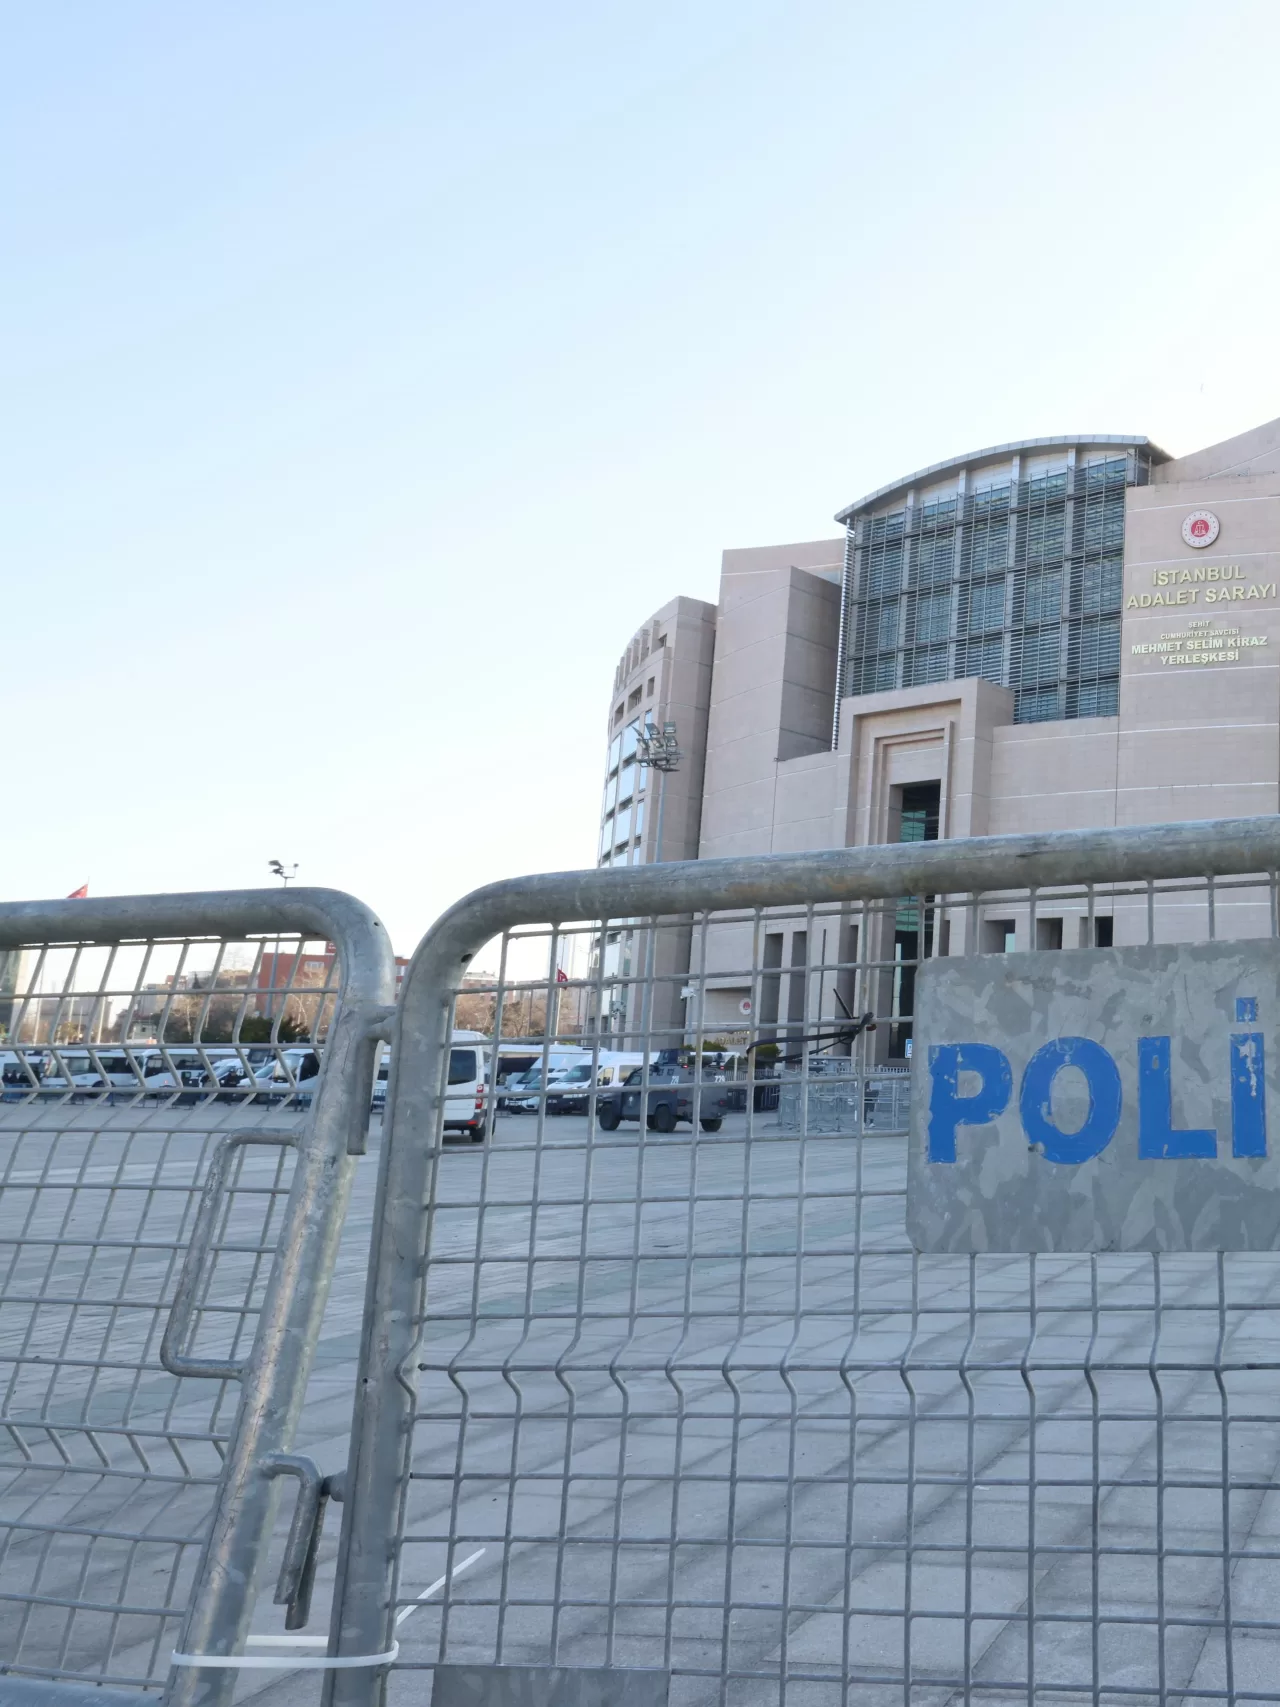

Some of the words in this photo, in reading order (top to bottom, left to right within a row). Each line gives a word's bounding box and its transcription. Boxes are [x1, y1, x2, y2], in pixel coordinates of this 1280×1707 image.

[1153, 565, 1246, 586] İSTANBUL
[1126, 588, 1200, 609] ADALET
[1206, 584, 1276, 602] SARAYI
[1188, 620, 1211, 629] ŞEHİT
[1160, 630, 1209, 640] CUMHURİYET
[1210, 628, 1240, 637] SAVCISI
[1131, 641, 1183, 655] MEHMET
[1186, 637, 1223, 650] SELİM
[1227, 635, 1268, 649] KİRAZ
[1160, 649, 1239, 666] YERLEŞKESİ
